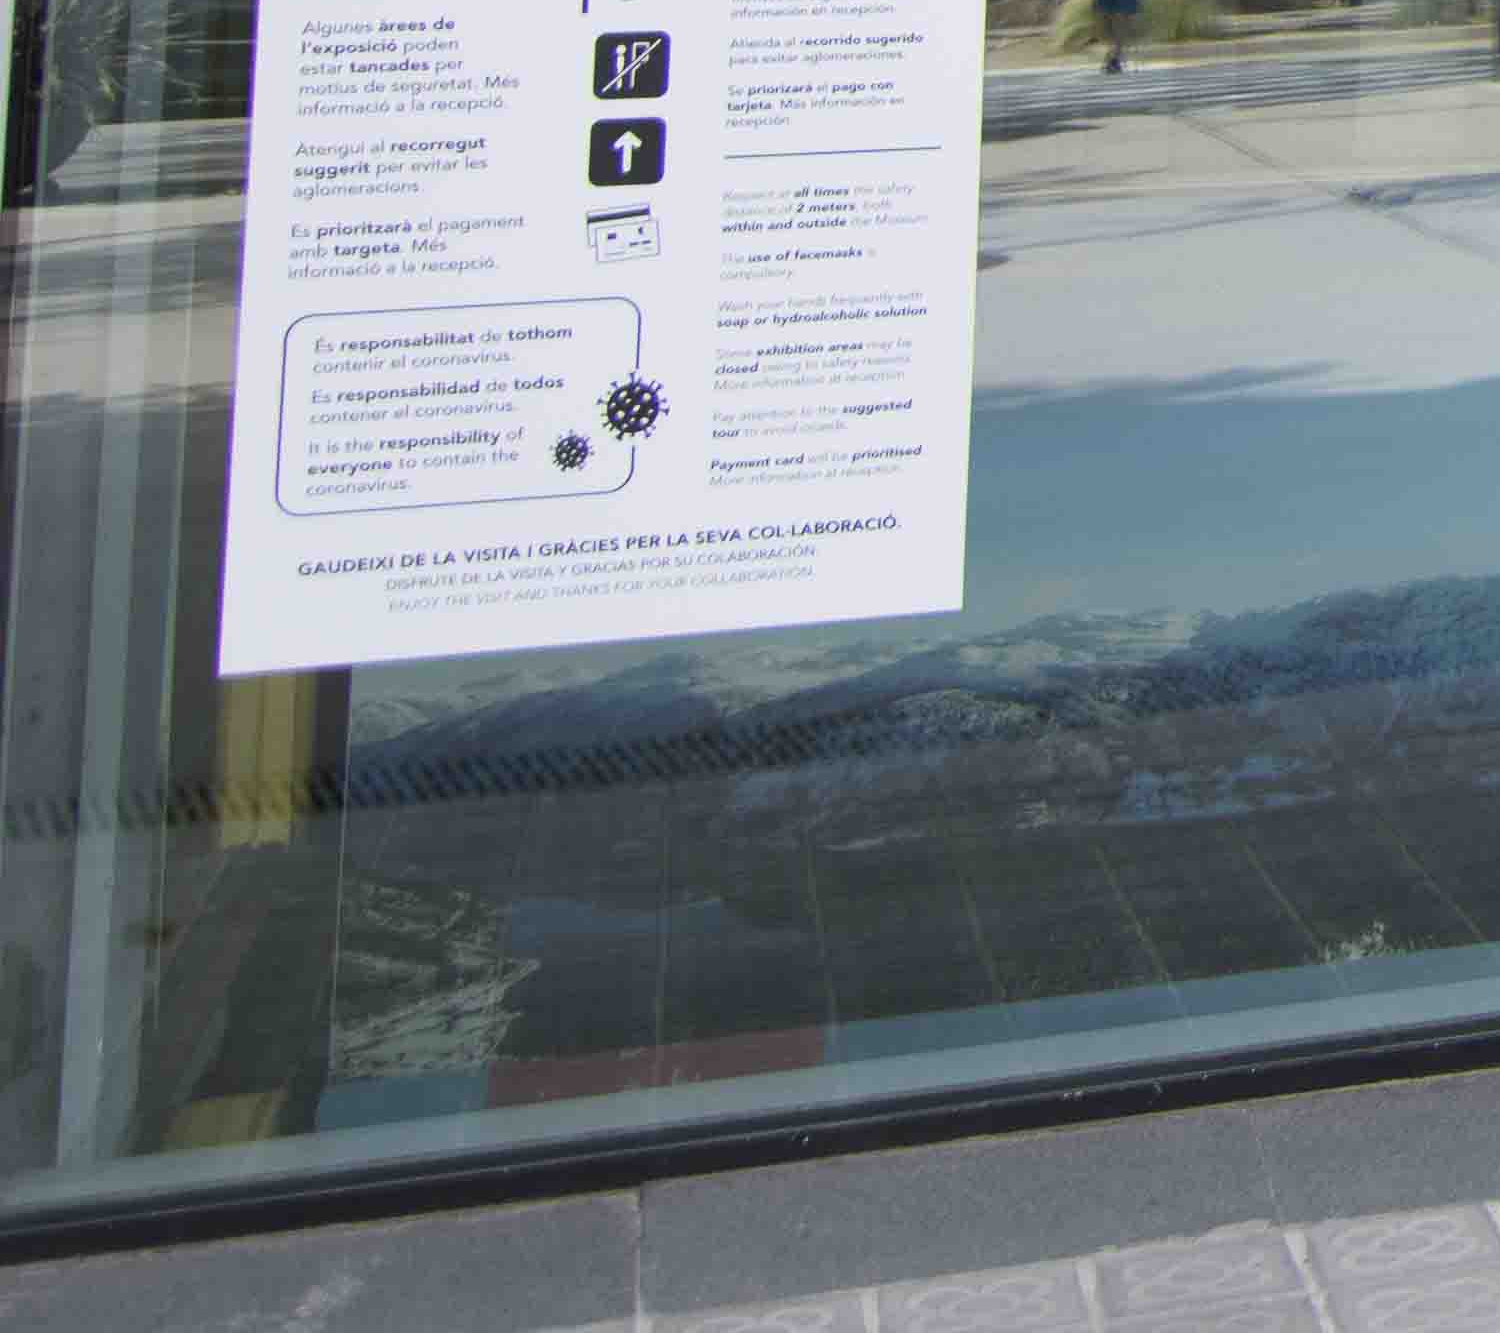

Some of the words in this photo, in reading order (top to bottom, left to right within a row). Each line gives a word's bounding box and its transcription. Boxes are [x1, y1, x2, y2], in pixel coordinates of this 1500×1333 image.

[301, 20, 374, 38] Algunes
[432, 15, 455, 30] de
[402, 36, 458, 55] poden
[299, 60, 344, 76] estar
[348, 58, 430, 73] tancades
[434, 59, 462, 75] per
[294, 141, 364, 159] Atengui
[369, 139, 385, 157] al
[389, 137, 486, 154] recorregut
[293, 160, 370, 180] suggerit
[375, 162, 404, 178] per
[410, 156, 458, 172] evitar
[464, 154, 488, 169] les
[417, 216, 432, 232] el
[436, 215, 524, 235] pagament
[289, 242, 328, 259] amb
[410, 236, 447, 253] Més
[716, 317, 750, 330] soap
[752, 316, 769, 325] or
[772, 307, 870, 327] hydroalcoholic
[873, 304, 927, 318] solution
[339, 331, 474, 354] responsabilitat
[479, 329, 501, 343] de
[507, 324, 572, 341] tothom
[312, 356, 384, 373] contenir
[389, 353, 407, 369] el
[336, 379, 480, 404] responsabilidad
[485, 379, 507, 393] de
[513, 374, 564, 391] todos
[309, 406, 389, 424] contener
[392, 403, 409, 419] el
[308, 441, 320, 453] It
[326, 439, 339, 453] is
[344, 438, 373, 451] the
[378, 428, 500, 452] responsibility
[505, 425, 524, 442] of
[306, 459, 392, 477] everyone
[398, 453, 417, 469] to
[421, 450, 486, 467] contain
[491, 446, 519, 462] the
[297, 555, 394, 576] GAUDEIXI
[399, 552, 425, 568] DE
[432, 550, 456, 565] LA
[463, 545, 520, 563] VISITA
[526, 543, 532, 558] I
[625, 534, 661, 549] PER
[666, 532, 689, 547] LA
[694, 527, 742, 545] SEVA
